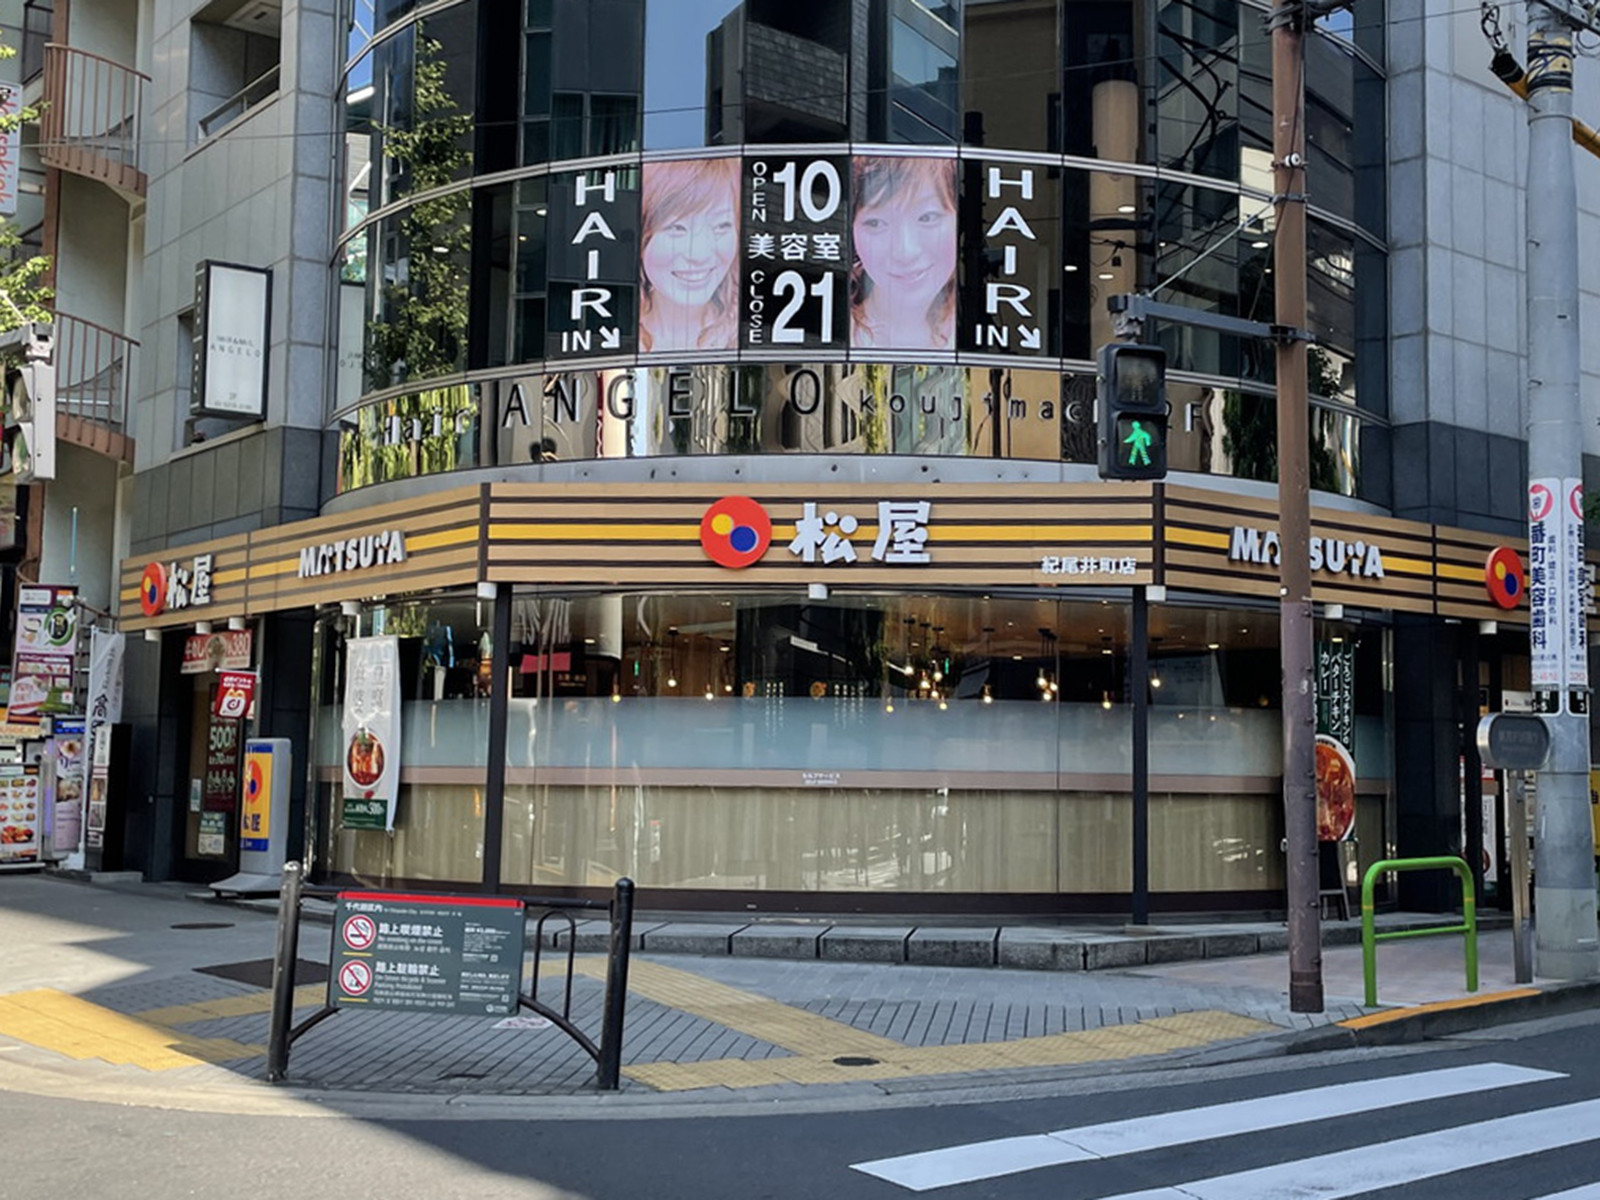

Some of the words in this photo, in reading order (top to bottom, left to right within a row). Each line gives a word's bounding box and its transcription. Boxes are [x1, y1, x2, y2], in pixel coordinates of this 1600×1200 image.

[752, 161, 767, 222] OPEN
[773, 160, 841, 222] 10
[572, 170, 616, 320] HAIR
[748, 233, 840, 260] 美容室
[986, 167, 1036, 317] HAIR
[750, 270, 765, 343] CLOSE
[772, 270, 834, 343] 21
[210, 344, 262, 358] ANGELO
[561, 330, 591, 352] IN
[976, 324, 1008, 347] IN
[502, 369, 822, 428] ANGELO
[298, 530, 405, 578] MATSUYA
[788, 501, 931, 564] 松屋
[1231, 526, 1384, 578] MASUYA
[166, 554, 213, 609] 松屋
[1041, 556, 1136, 575] 紀尾井町店
[1531, 522, 1547, 650] 番町美容歯科
[1320, 651, 1330, 691] カレー
[1331, 652, 1342, 731] バターチキン
[1343, 652, 1353, 744] ごろごろチキンの
